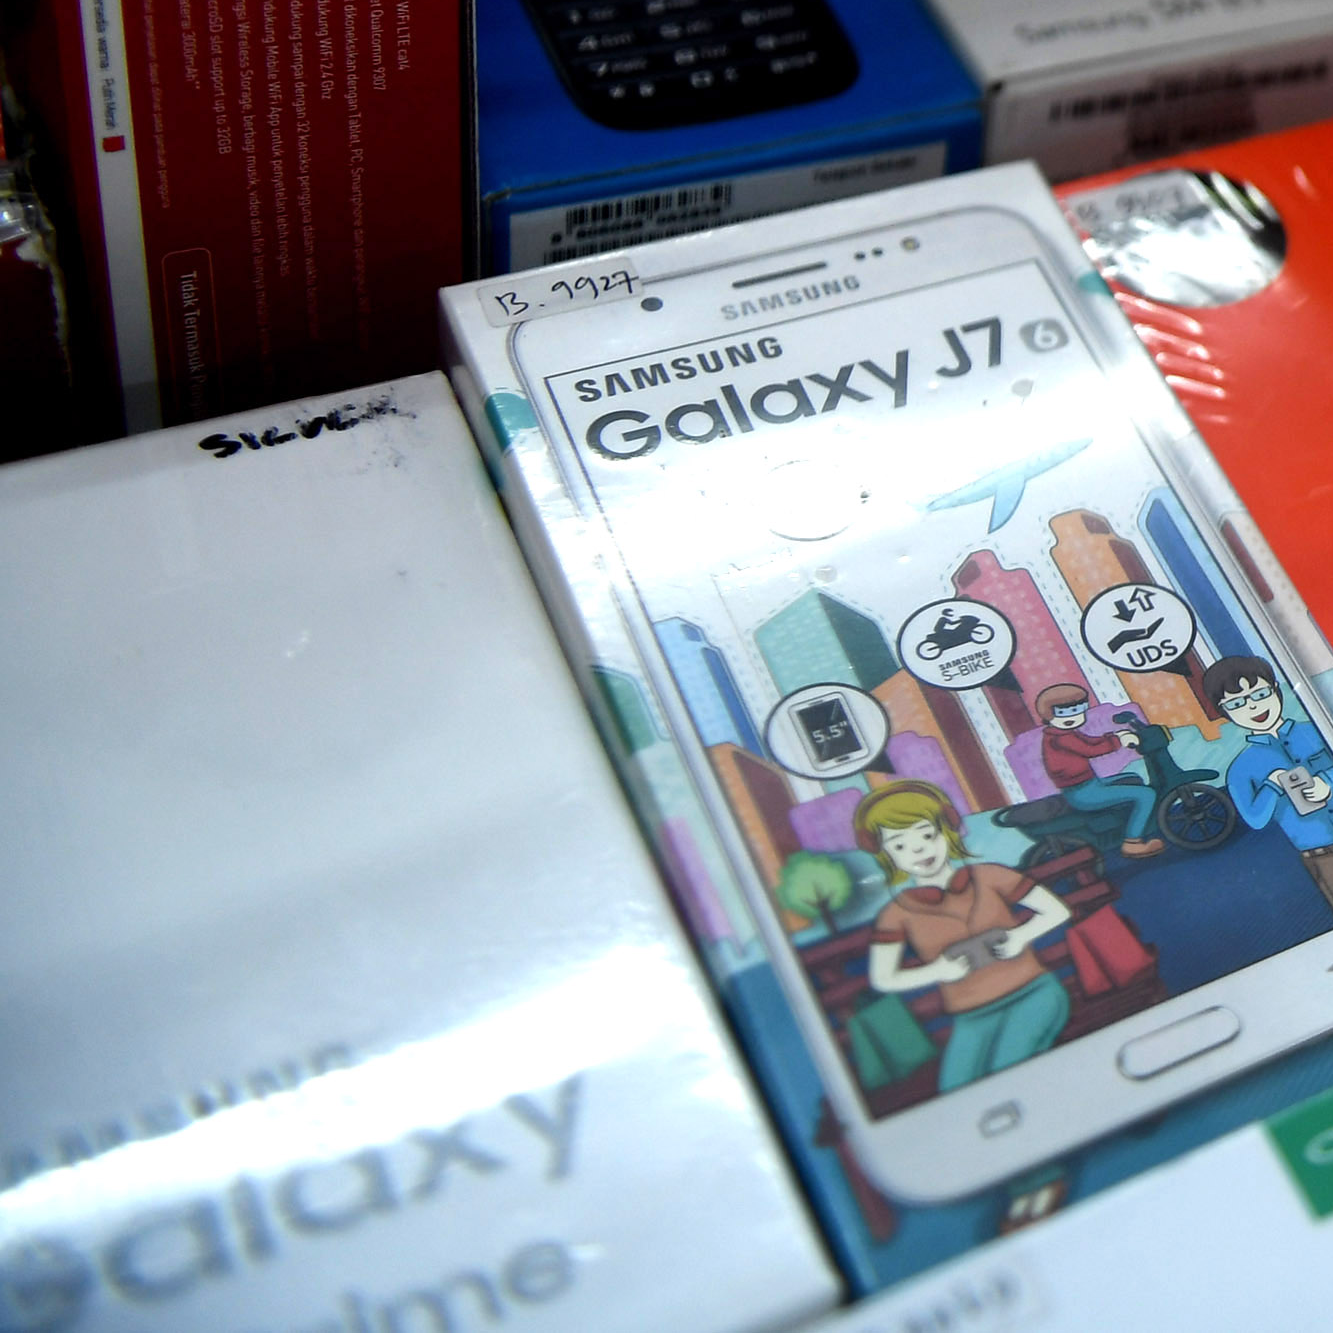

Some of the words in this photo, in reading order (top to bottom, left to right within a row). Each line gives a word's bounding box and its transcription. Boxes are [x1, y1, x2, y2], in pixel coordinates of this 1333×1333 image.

[396, 1, 408, 26] WiFi
[209, 35, 225, 56] slot
[237, 21, 251, 68] Wireless
[319, 37, 332, 61] WiFi
[344, 5, 359, 72] dikoneksikan
[369, 10, 384, 65] Qualcomm
[396, 27, 409, 46] LTE
[266, 45, 280, 80] Mobile
[291, 42, 306, 79] sampai
[320, 63, 333, 78] 2.4
[210, 57, 227, 97] support
[239, 69, 254, 113] Storage,
[321, 80, 334, 100] Ghz
[372, 66, 386, 91] 9307
[212, 99, 228, 112] up
[268, 81, 282, 105] WiFi
[292, 81, 307, 118] dengan
[344, 74, 360, 110] dengan
[216, 114, 228, 125] to
[267, 107, 283, 127] App
[296, 120, 310, 133] 32
[217, 126, 233, 155] 32GB
[242, 115, 256, 154] berbagi
[270, 129, 283, 157] untuk
[297, 135, 311, 174] koneksi
[248, 191, 262, 217] video
[250, 218, 264, 237] dan
[180, 270, 199, 307] Tidak
[550, 268, 641, 304] 9927
[719, 274, 861, 323] SAMSUNG
[183, 310, 203, 373] Termasuk
[574, 335, 783, 404] SAMSUNG
[585, 349, 910, 463] Galaxy
[934, 316, 1003, 381] J7
[938, 649, 990, 671] SAMSUNG
[1126, 638, 1179, 668] UDS
[941, 657, 995, 683] S-BIKE
